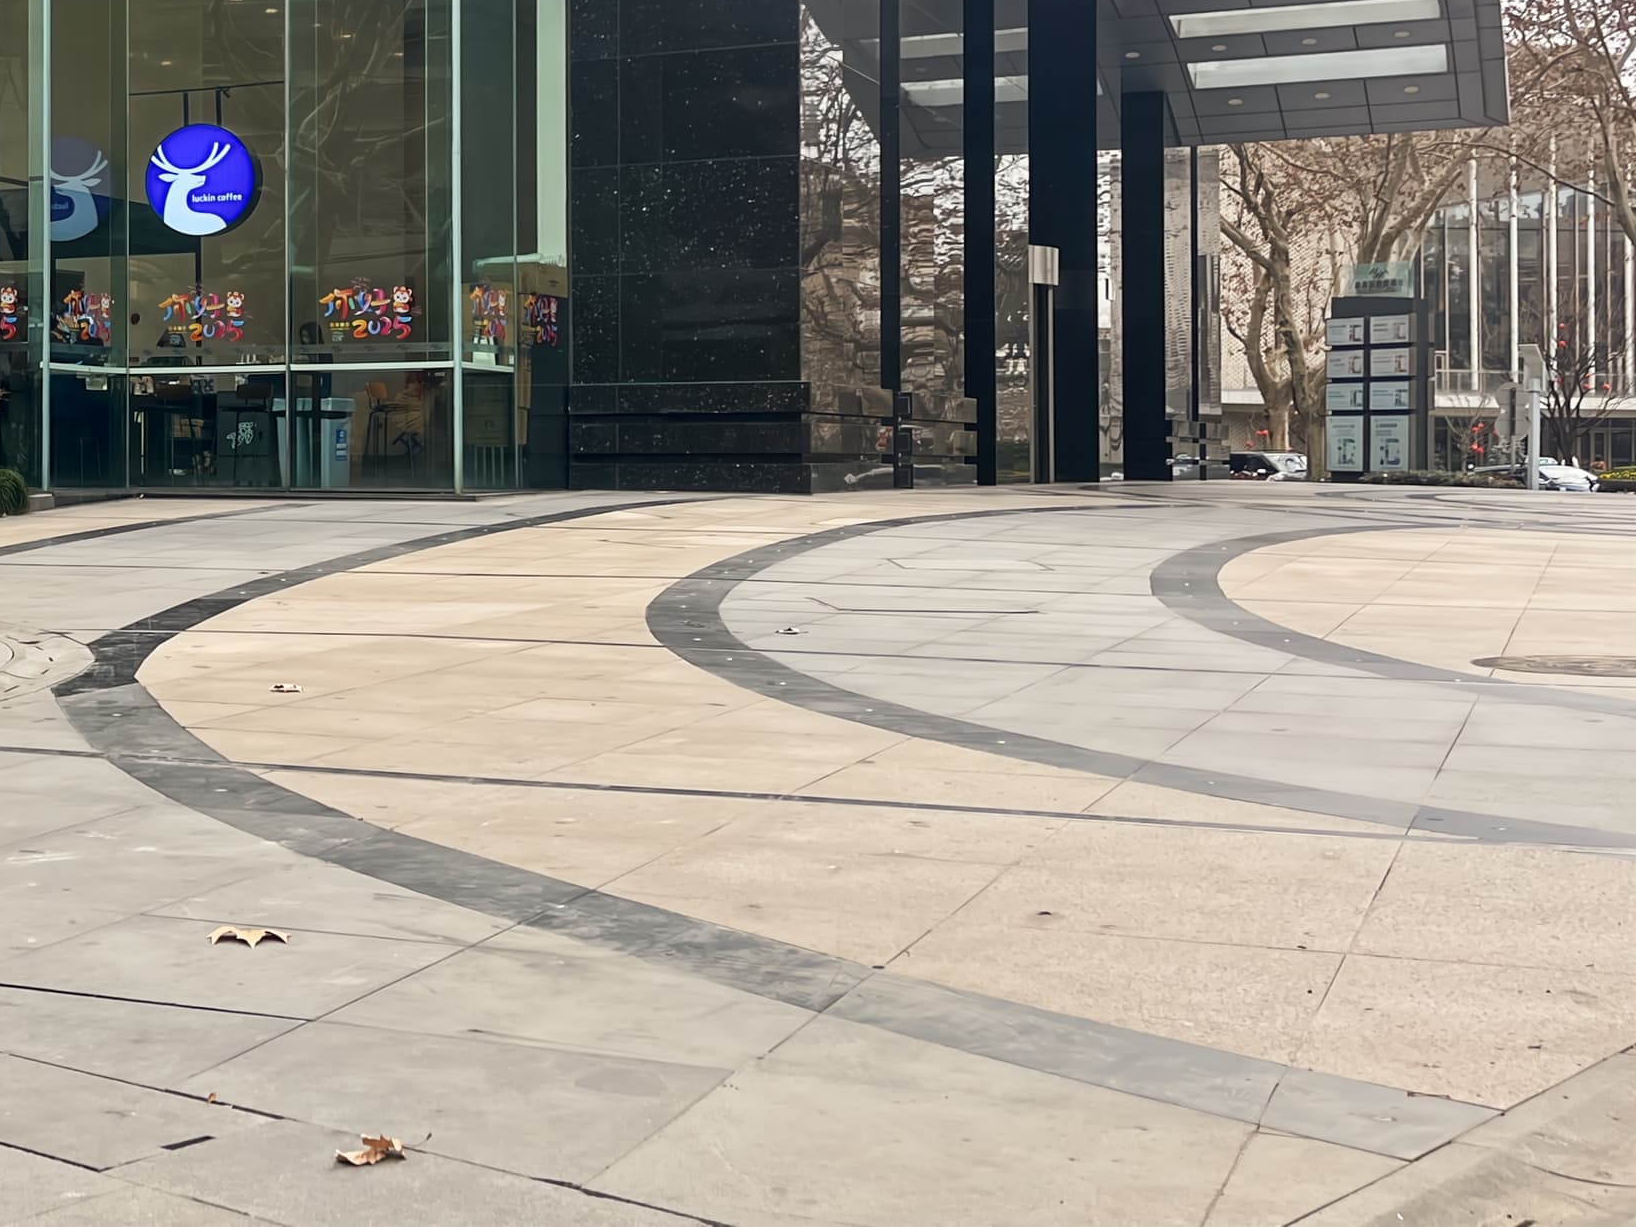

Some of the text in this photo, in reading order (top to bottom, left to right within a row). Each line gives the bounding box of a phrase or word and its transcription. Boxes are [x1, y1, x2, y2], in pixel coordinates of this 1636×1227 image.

[192, 192, 243, 202] luckin coffee
[188, 319, 245, 342] 2025
[351, 316, 413, 340] 2025
